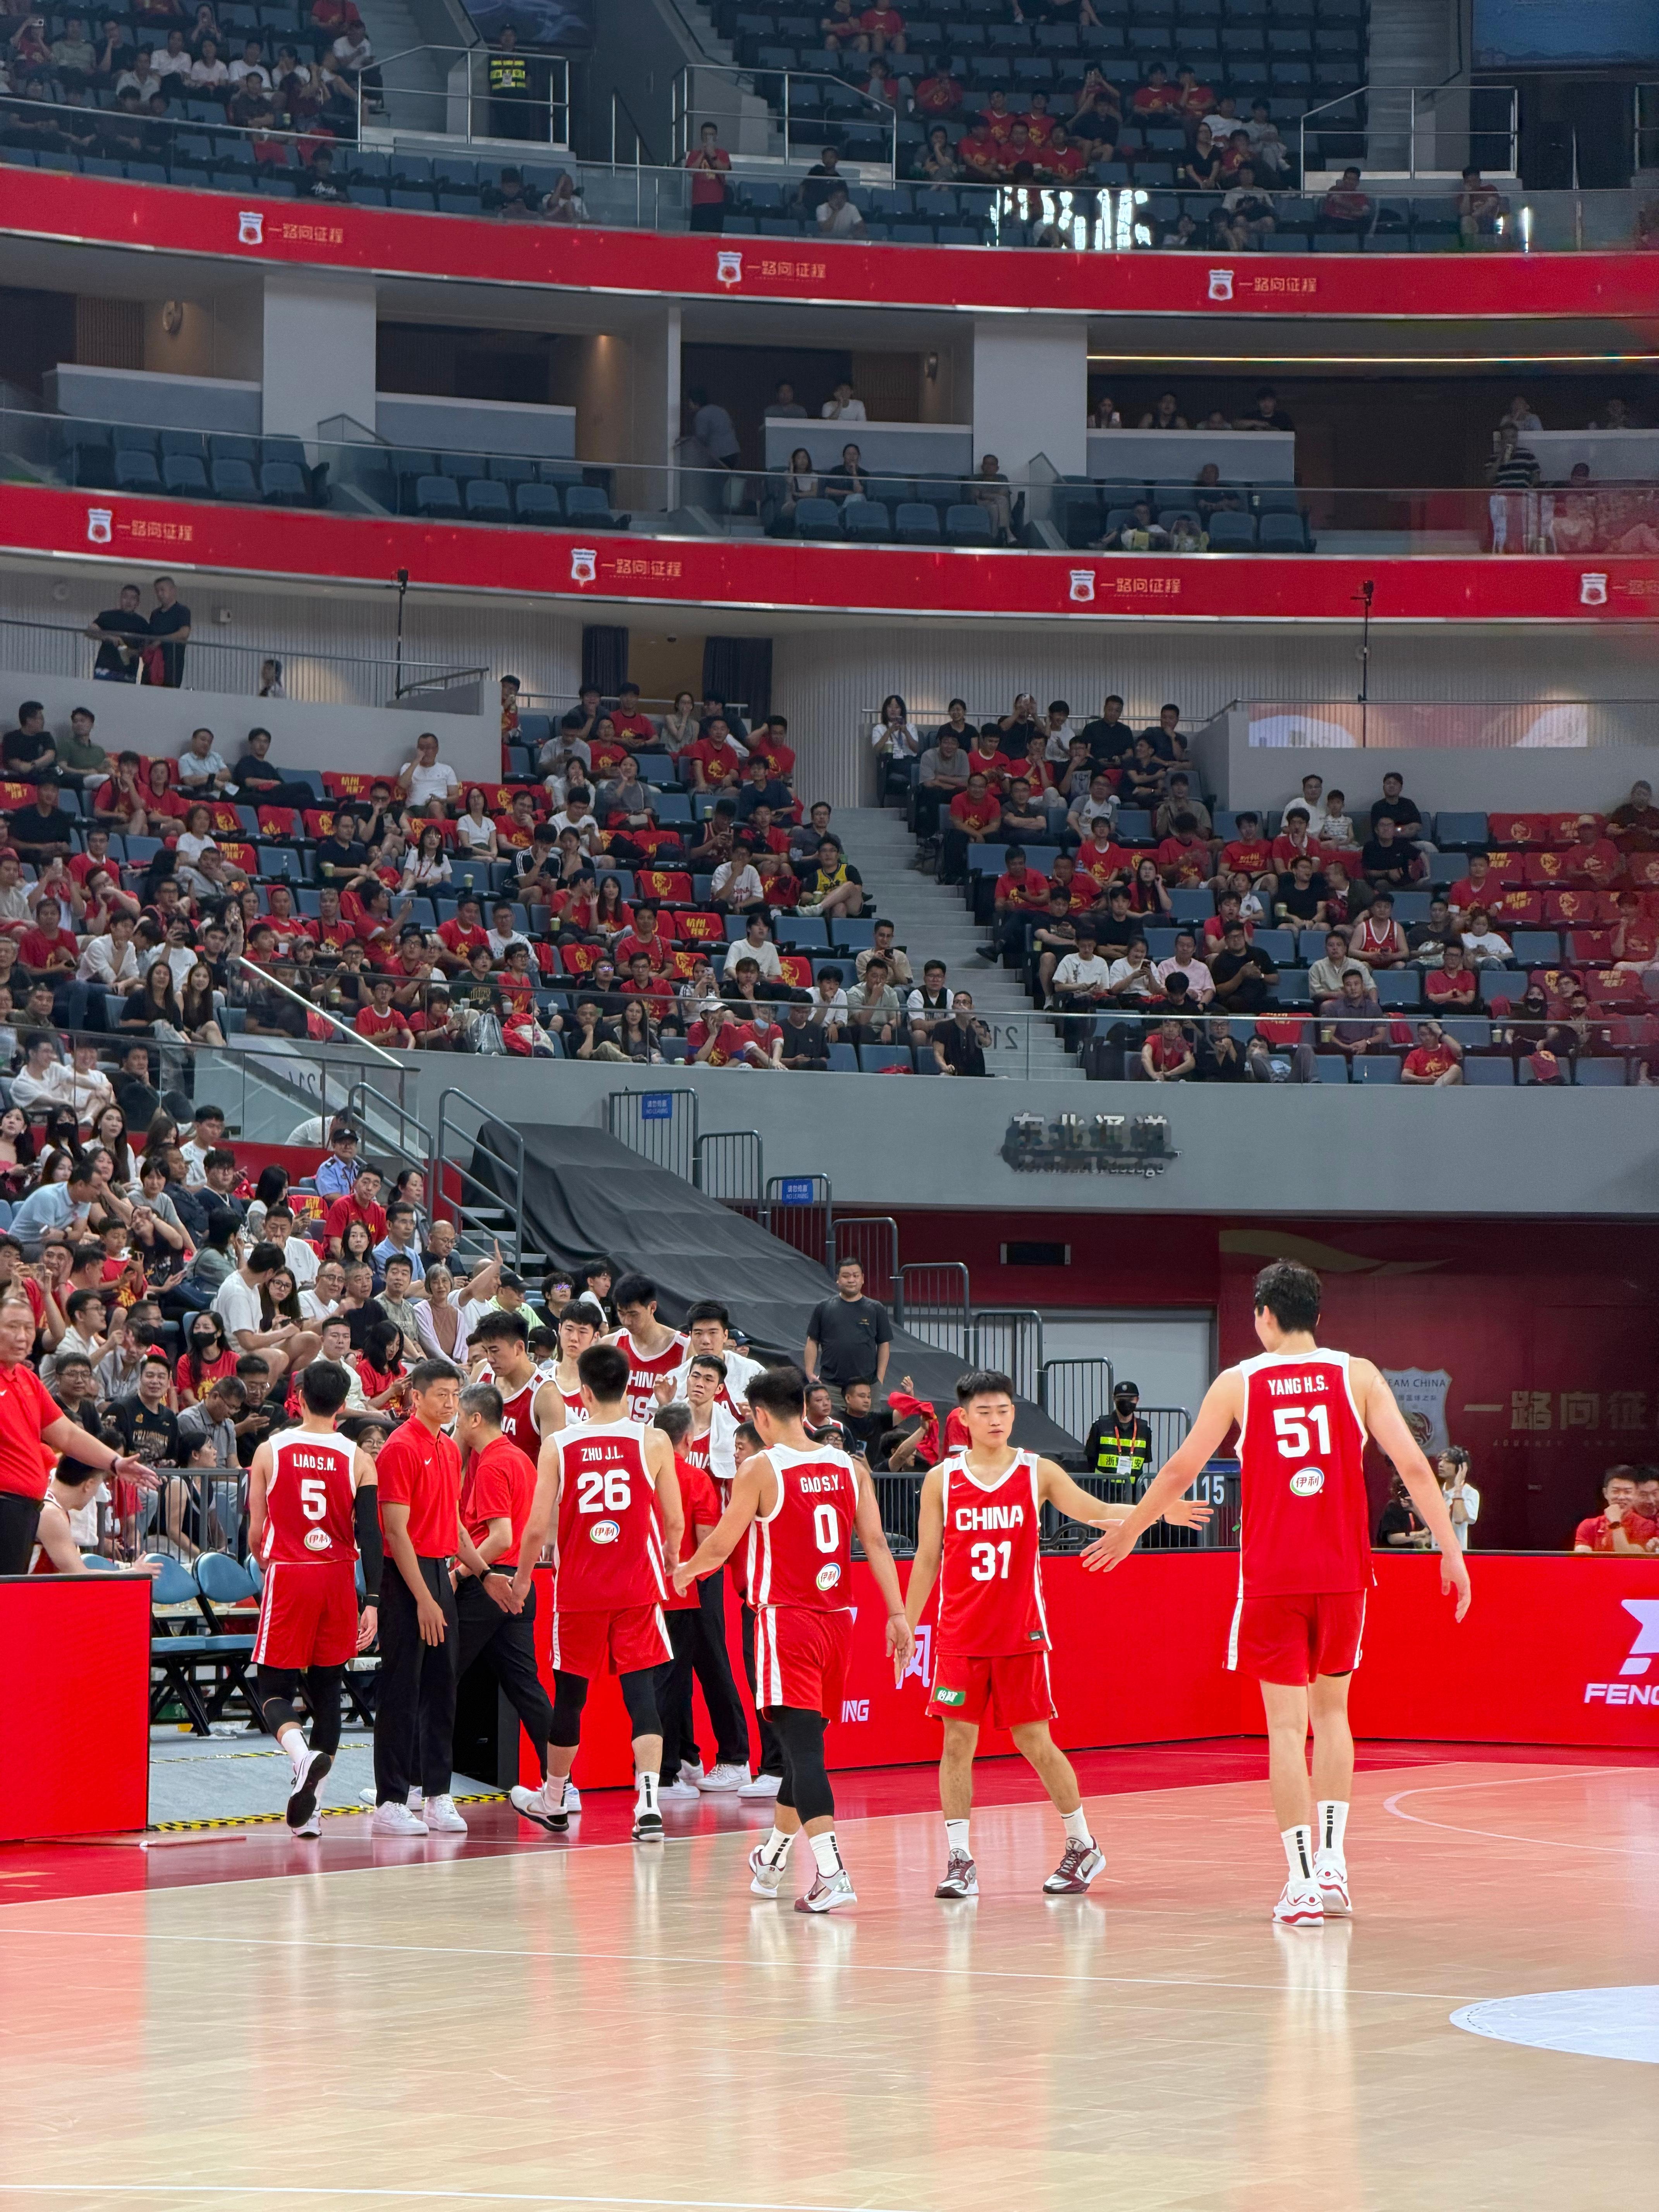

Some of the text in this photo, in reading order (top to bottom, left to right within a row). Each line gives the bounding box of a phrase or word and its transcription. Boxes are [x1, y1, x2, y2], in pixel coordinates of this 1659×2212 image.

[747, 261, 826, 278] 一路向征程
[1239, 278, 1316, 292] 一路向征程
[601, 559, 682, 577] 一路向征程
[1100, 579, 1180, 593] 一路向征程
[1267, 1375, 1329, 1396] YANG H.S.
[1388, 1379, 1446, 1387] EAM CHINA
[1463, 1391, 1659, 1430] 一路向征
[1273, 1405, 1331, 1458] 51
[293, 1453, 337, 1471] LIAO S.N.
[581, 1446, 624, 1462] ZHU J.L.
[800, 1474, 844, 1493] GAO S.Y.
[1296, 1476, 1319, 1488] 伊利
[301, 1479, 327, 1520] 5
[577, 1469, 631, 1514] 26
[955, 1505, 1024, 1531] CHINA
[595, 1527, 615, 1537] 伊利
[814, 1504, 840, 1554] 0
[971, 1541, 1012, 1581] 31
[821, 1570, 837, 1583] 伊利
